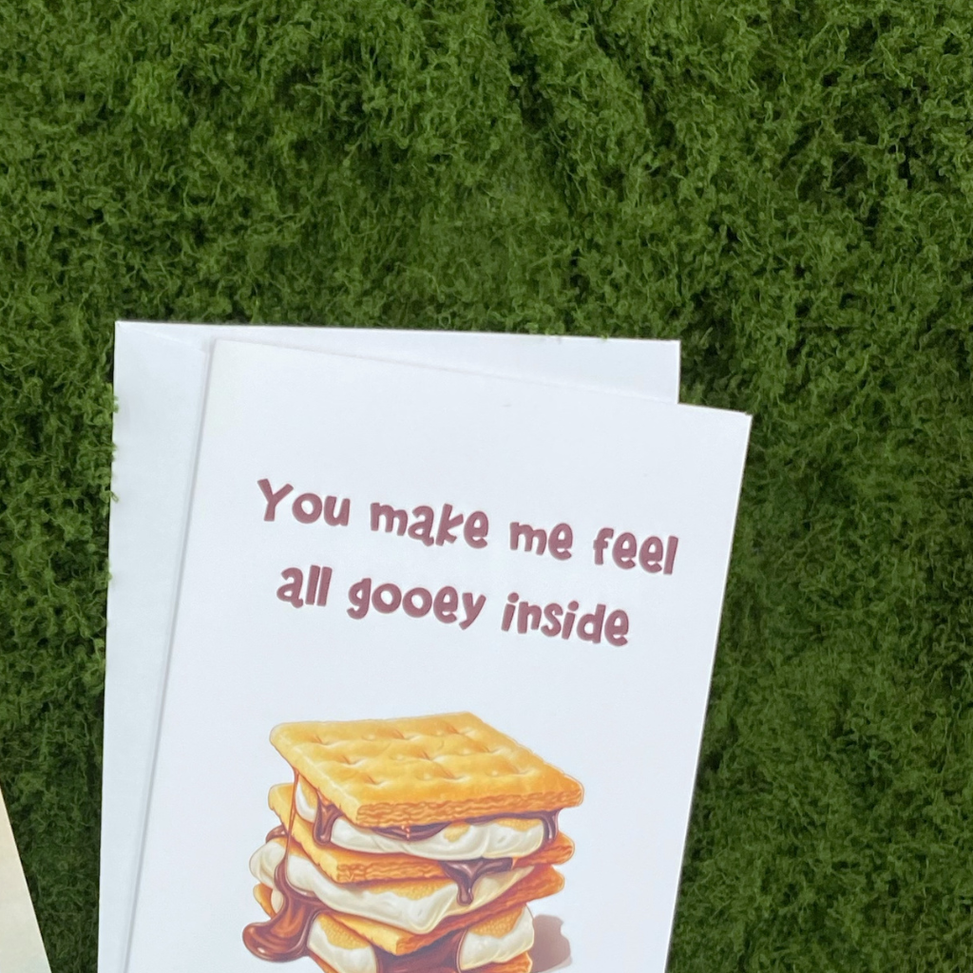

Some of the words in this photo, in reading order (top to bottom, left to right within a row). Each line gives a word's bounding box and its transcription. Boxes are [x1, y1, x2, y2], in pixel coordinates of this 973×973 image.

[256, 477, 351, 527] You
[369, 502, 490, 547] make
[509, 521, 574, 561] me
[593, 527, 680, 576] feel
[275, 564, 333, 609] all
[346, 576, 487, 631] gooey
[500, 591, 630, 647] inside
